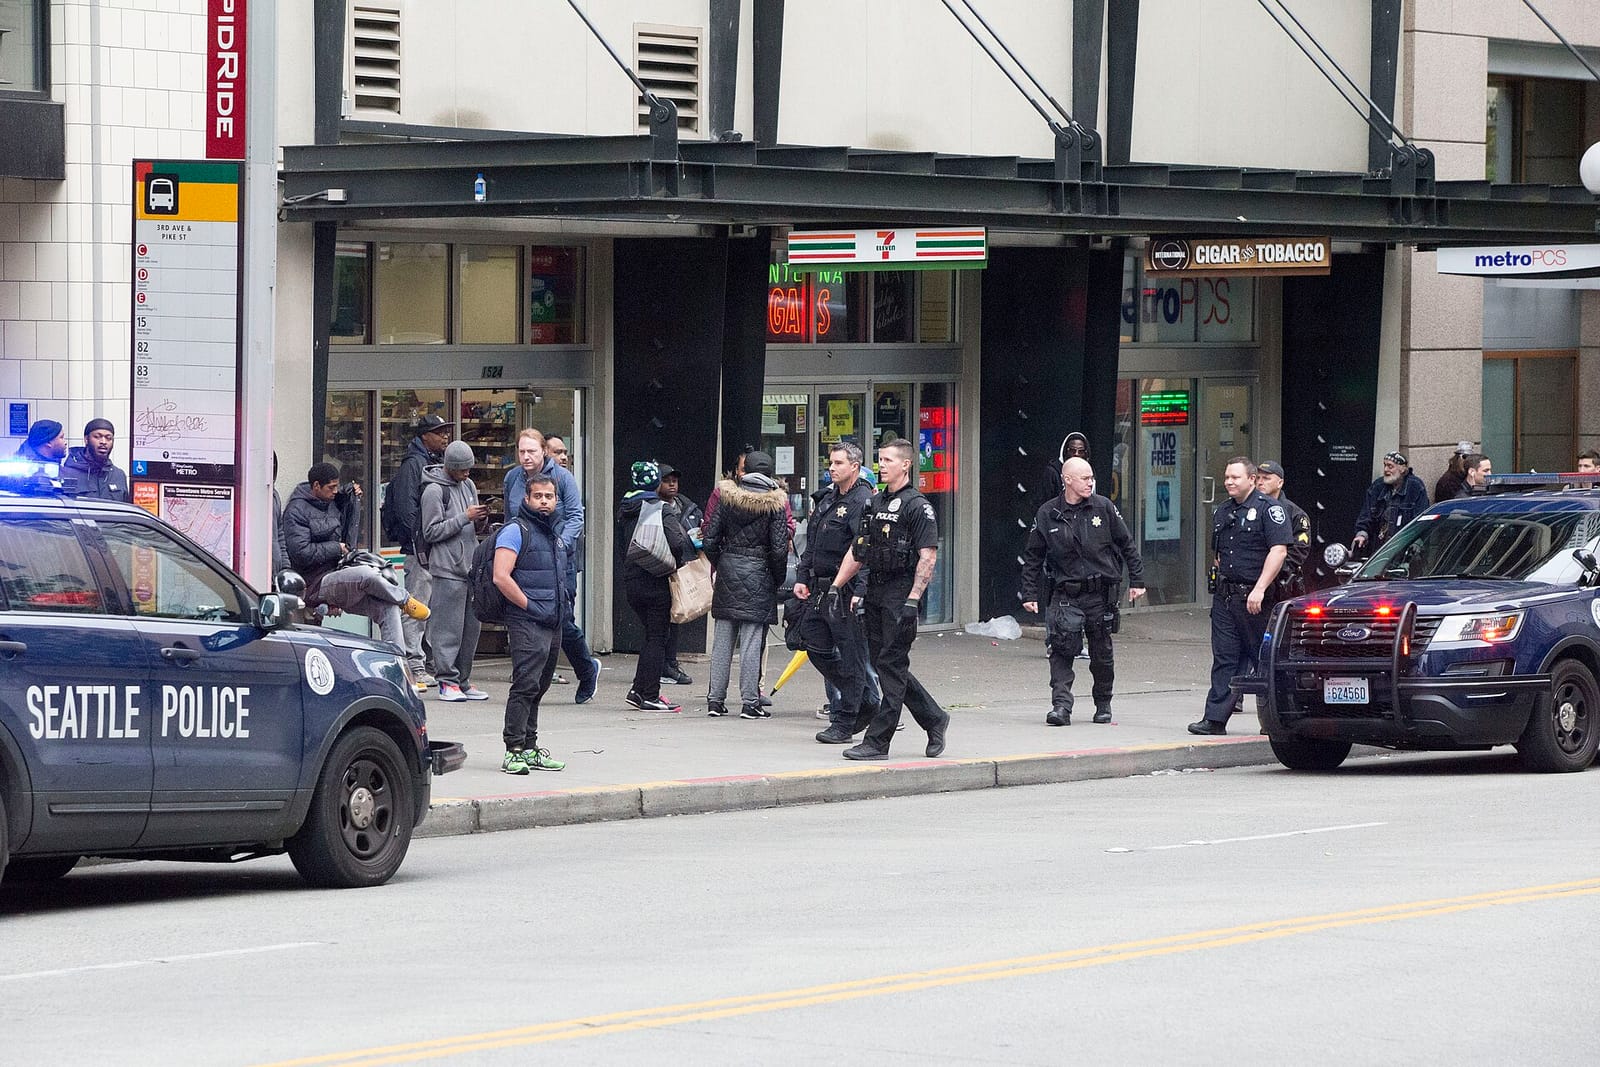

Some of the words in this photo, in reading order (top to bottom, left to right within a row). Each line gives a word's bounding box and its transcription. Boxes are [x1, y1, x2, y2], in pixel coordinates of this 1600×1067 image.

[161, 233, 176, 241] PIKE
[137, 244, 147, 255] C
[1195, 245, 1240, 264] CIGAR
[1256, 243, 1325, 262] TOBACCO
[1475, 249, 1567, 267] metroPCS
[138, 269, 148, 280] D
[138, 293, 146, 303] E
[137, 316, 147, 328] 15
[137, 341, 149, 353] 82
[136, 365, 149, 377] 83
[481, 365, 503, 378] 1524
[1151, 432, 1176, 449] TWO
[1151, 450, 1176, 466] FREE
[175, 468, 198, 476] METRO
[875, 512, 900, 522] POLICE
[26, 685, 141, 739] SEATTLE
[161, 685, 250, 739] POLICE
